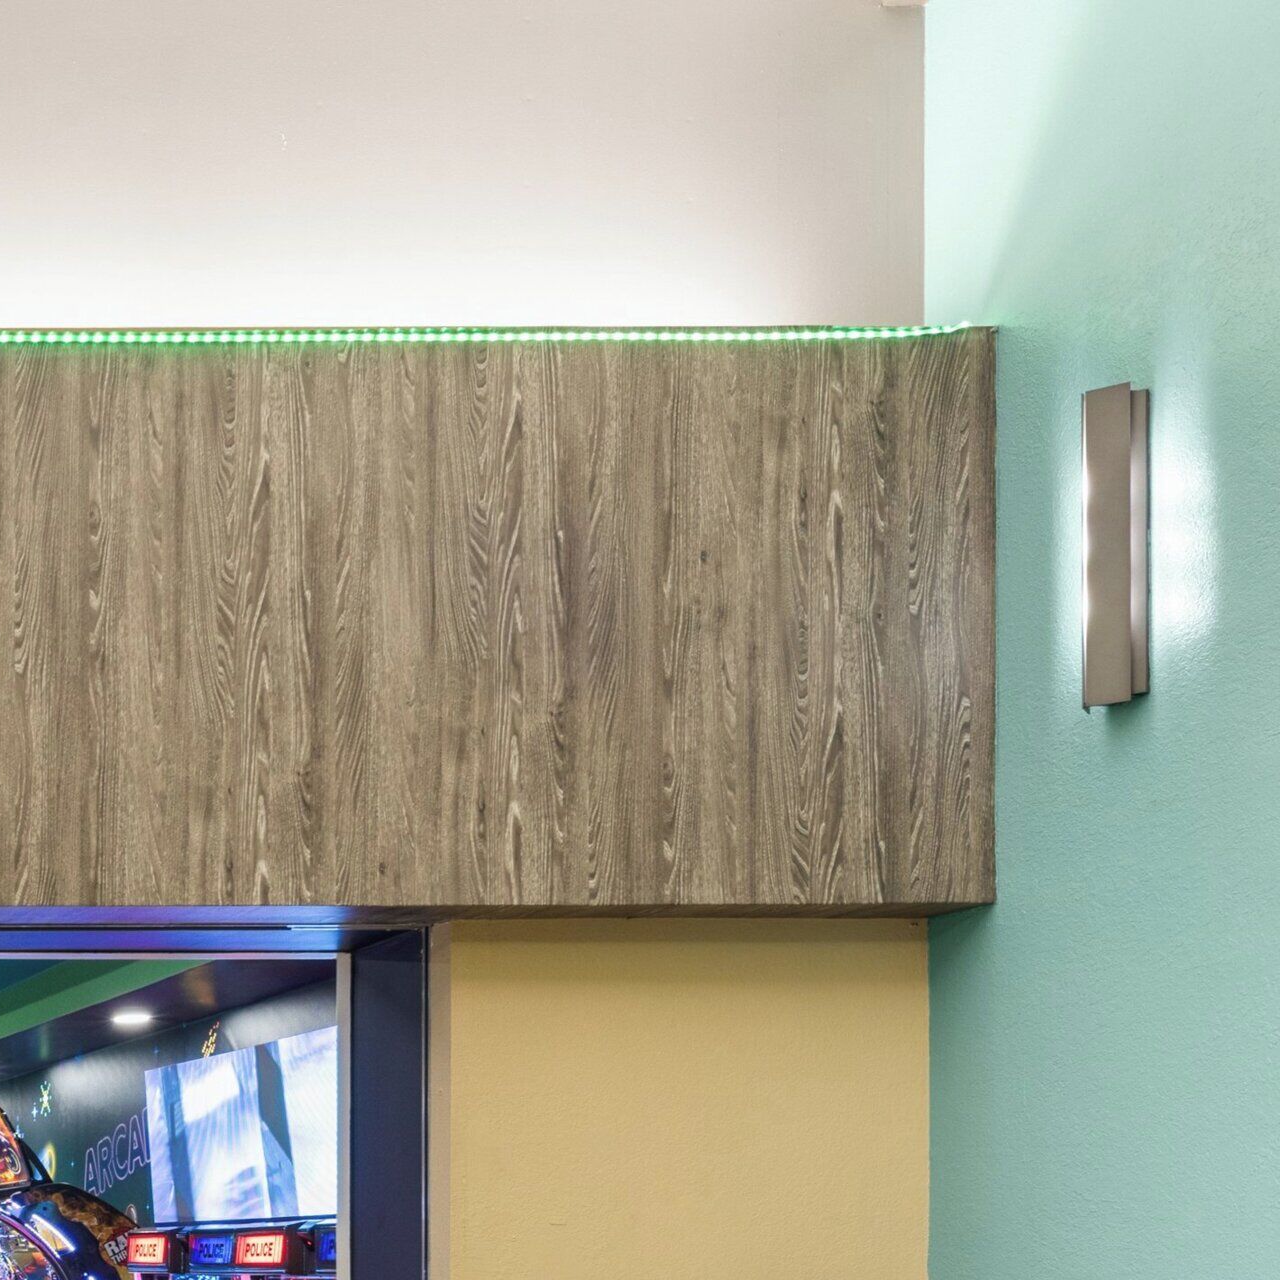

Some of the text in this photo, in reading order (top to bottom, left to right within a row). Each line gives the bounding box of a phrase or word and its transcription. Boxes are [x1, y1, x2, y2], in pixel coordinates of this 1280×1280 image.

[104, 1231, 128, 1256] RA
[135, 1243, 157, 1258] POLICE
[198, 1243, 225, 1258] POLICE
[245, 1242, 274, 1257] POLICE
